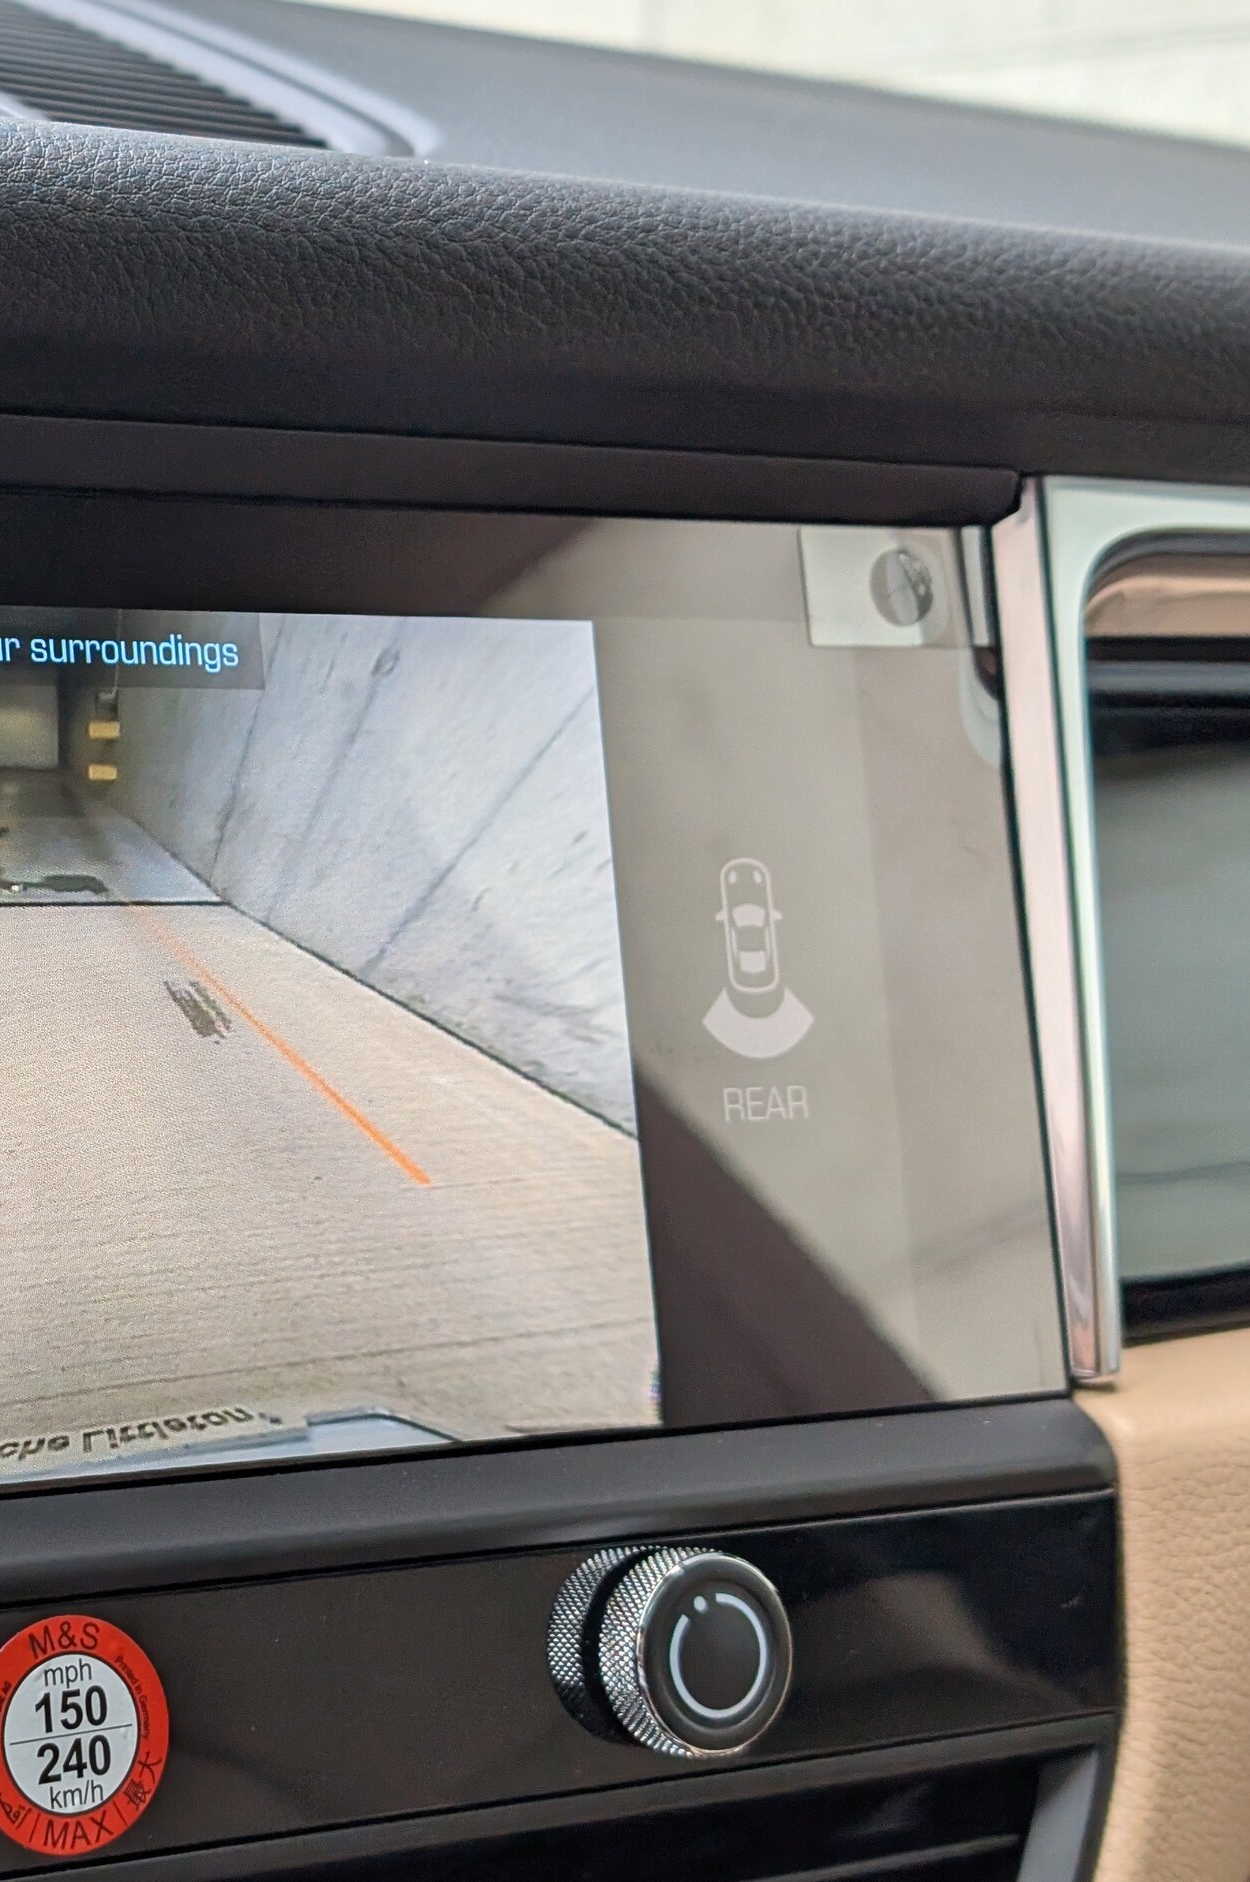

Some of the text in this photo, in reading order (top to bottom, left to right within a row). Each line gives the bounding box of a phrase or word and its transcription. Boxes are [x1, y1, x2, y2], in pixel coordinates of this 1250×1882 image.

[31, 634, 239, 673] surroundings
[723, 1085, 809, 1122] REAR
[28, 1620, 100, 1659] M&S
[43, 1658, 93, 1688] mph
[34, 1684, 108, 1734] 150
[115, 1655, 138, 1685] Printed
[139, 1694, 150, 1740] Germany
[36, 1734, 111, 1785] 240
[49, 1779, 104, 1810] km/h
[43, 1810, 114, 1849] MAX
